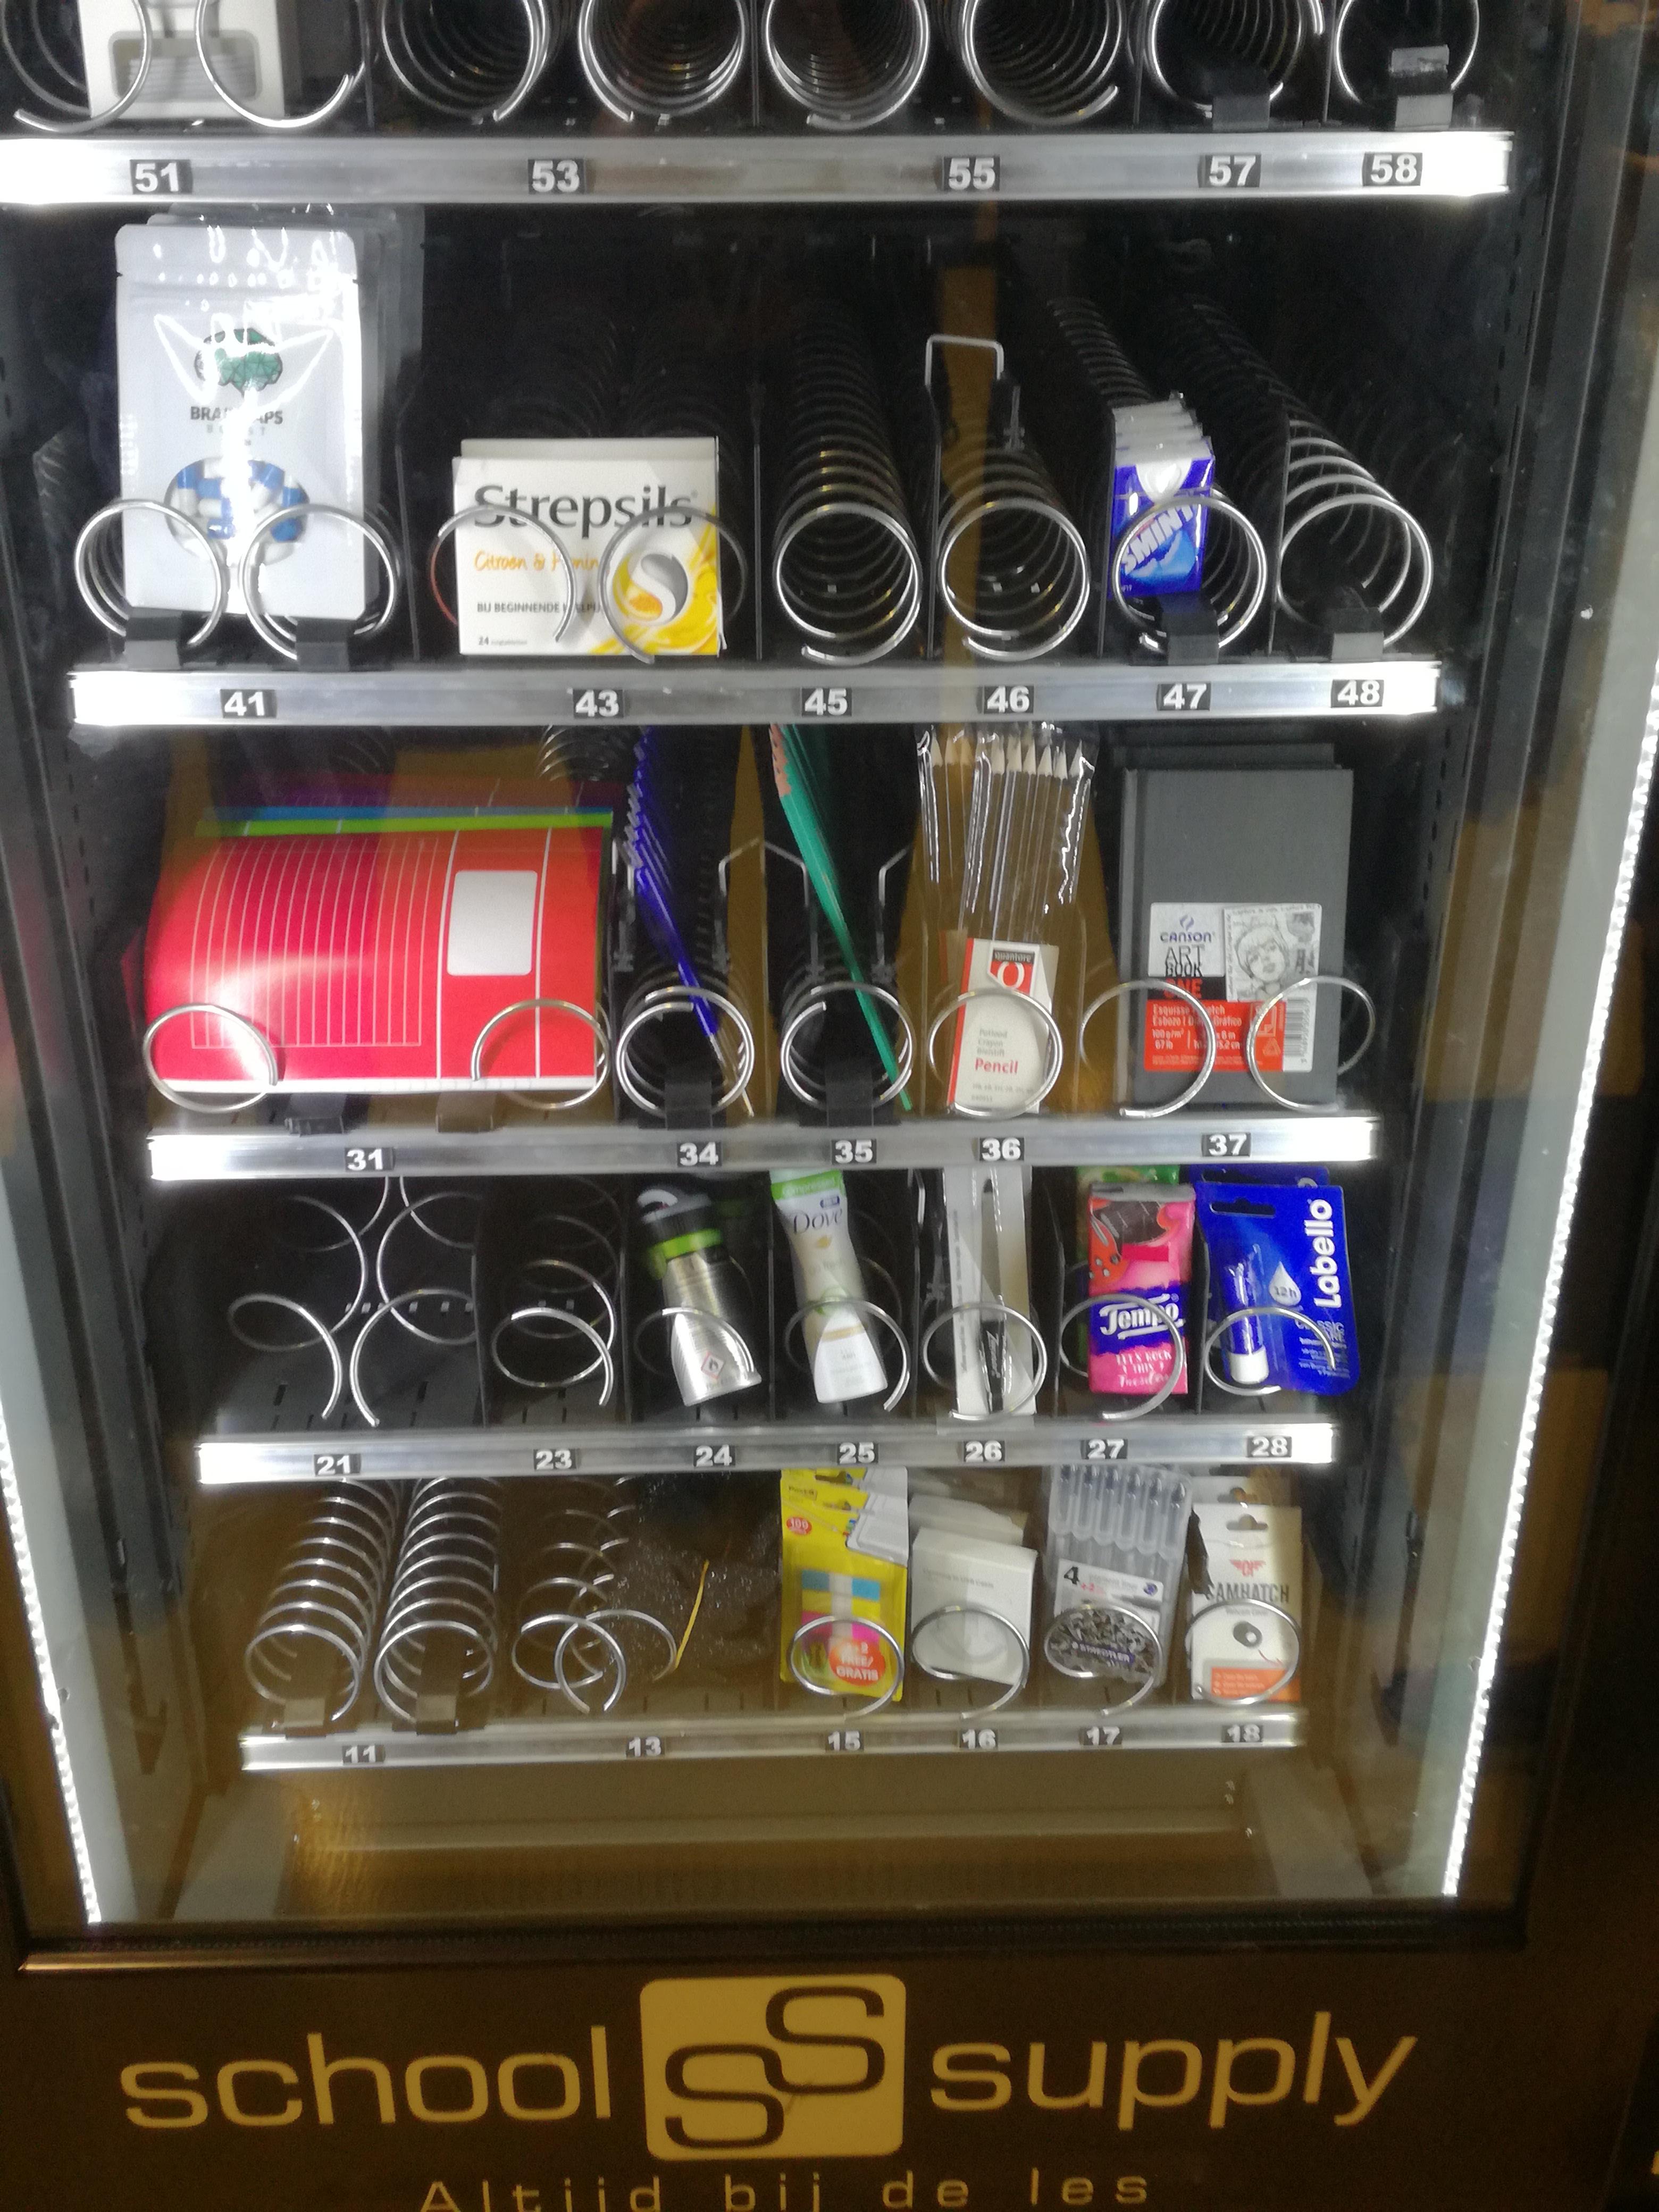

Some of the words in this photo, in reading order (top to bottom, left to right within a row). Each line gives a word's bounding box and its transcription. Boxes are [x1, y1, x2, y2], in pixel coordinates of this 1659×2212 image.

[135, 162, 179, 192] 51
[532, 161, 580, 192] 53
[949, 157, 995, 189] 55
[1209, 155, 1256, 186] 57
[1370, 153, 1418, 185] 58
[474, 484, 692, 540] Strepsils
[1121, 504, 1194, 575] SMINT
[494, 601, 560, 613] BEGINNENDE
[478, 636, 489, 646] 24
[224, 691, 265, 716] 41
[575, 690, 619, 717] 43
[805, 688, 847, 715] 45
[987, 685, 1030, 713] 46
[1163, 683, 1207, 709] 47
[1337, 680, 1380, 706] 48
[1166, 945, 1205, 964] ART
[975, 1057, 1018, 1074] Pencil
[680, 1142, 719, 1167] 34
[835, 1139, 873, 1163] 35
[982, 1138, 1021, 1162] 36
[1209, 1134, 1247, 1156] 37
[347, 1148, 383, 1170] 31
[793, 1208, 843, 1234] Dove
[1304, 1199, 1342, 1309] Labello
[1099, 1293, 1182, 1336] Tempo
[696, 1446, 732, 1467] 24
[839, 1443, 875, 1464] 25
[965, 1440, 1002, 1462] 26
[1088, 1439, 1125, 1459] 27
[1252, 1436, 1290, 1456] 28
[316, 1455, 350, 1474] 21
[535, 1449, 572, 1470] 23
[1063, 1565, 1079, 1586] 4
[828, 1731, 860, 1752] 15
[962, 1729, 996, 1750] 16
[1086, 1726, 1120, 1746] 17
[1227, 1724, 1261, 1744] 18
[345, 1745, 376, 1763] 11
[629, 1737, 661, 1756] 13
[120, 2024, 611, 2128] school
[930, 2010, 1418, 2131] supply
[881, 2169, 970, 2209] de
[1030, 2166, 1149, 2205] les
